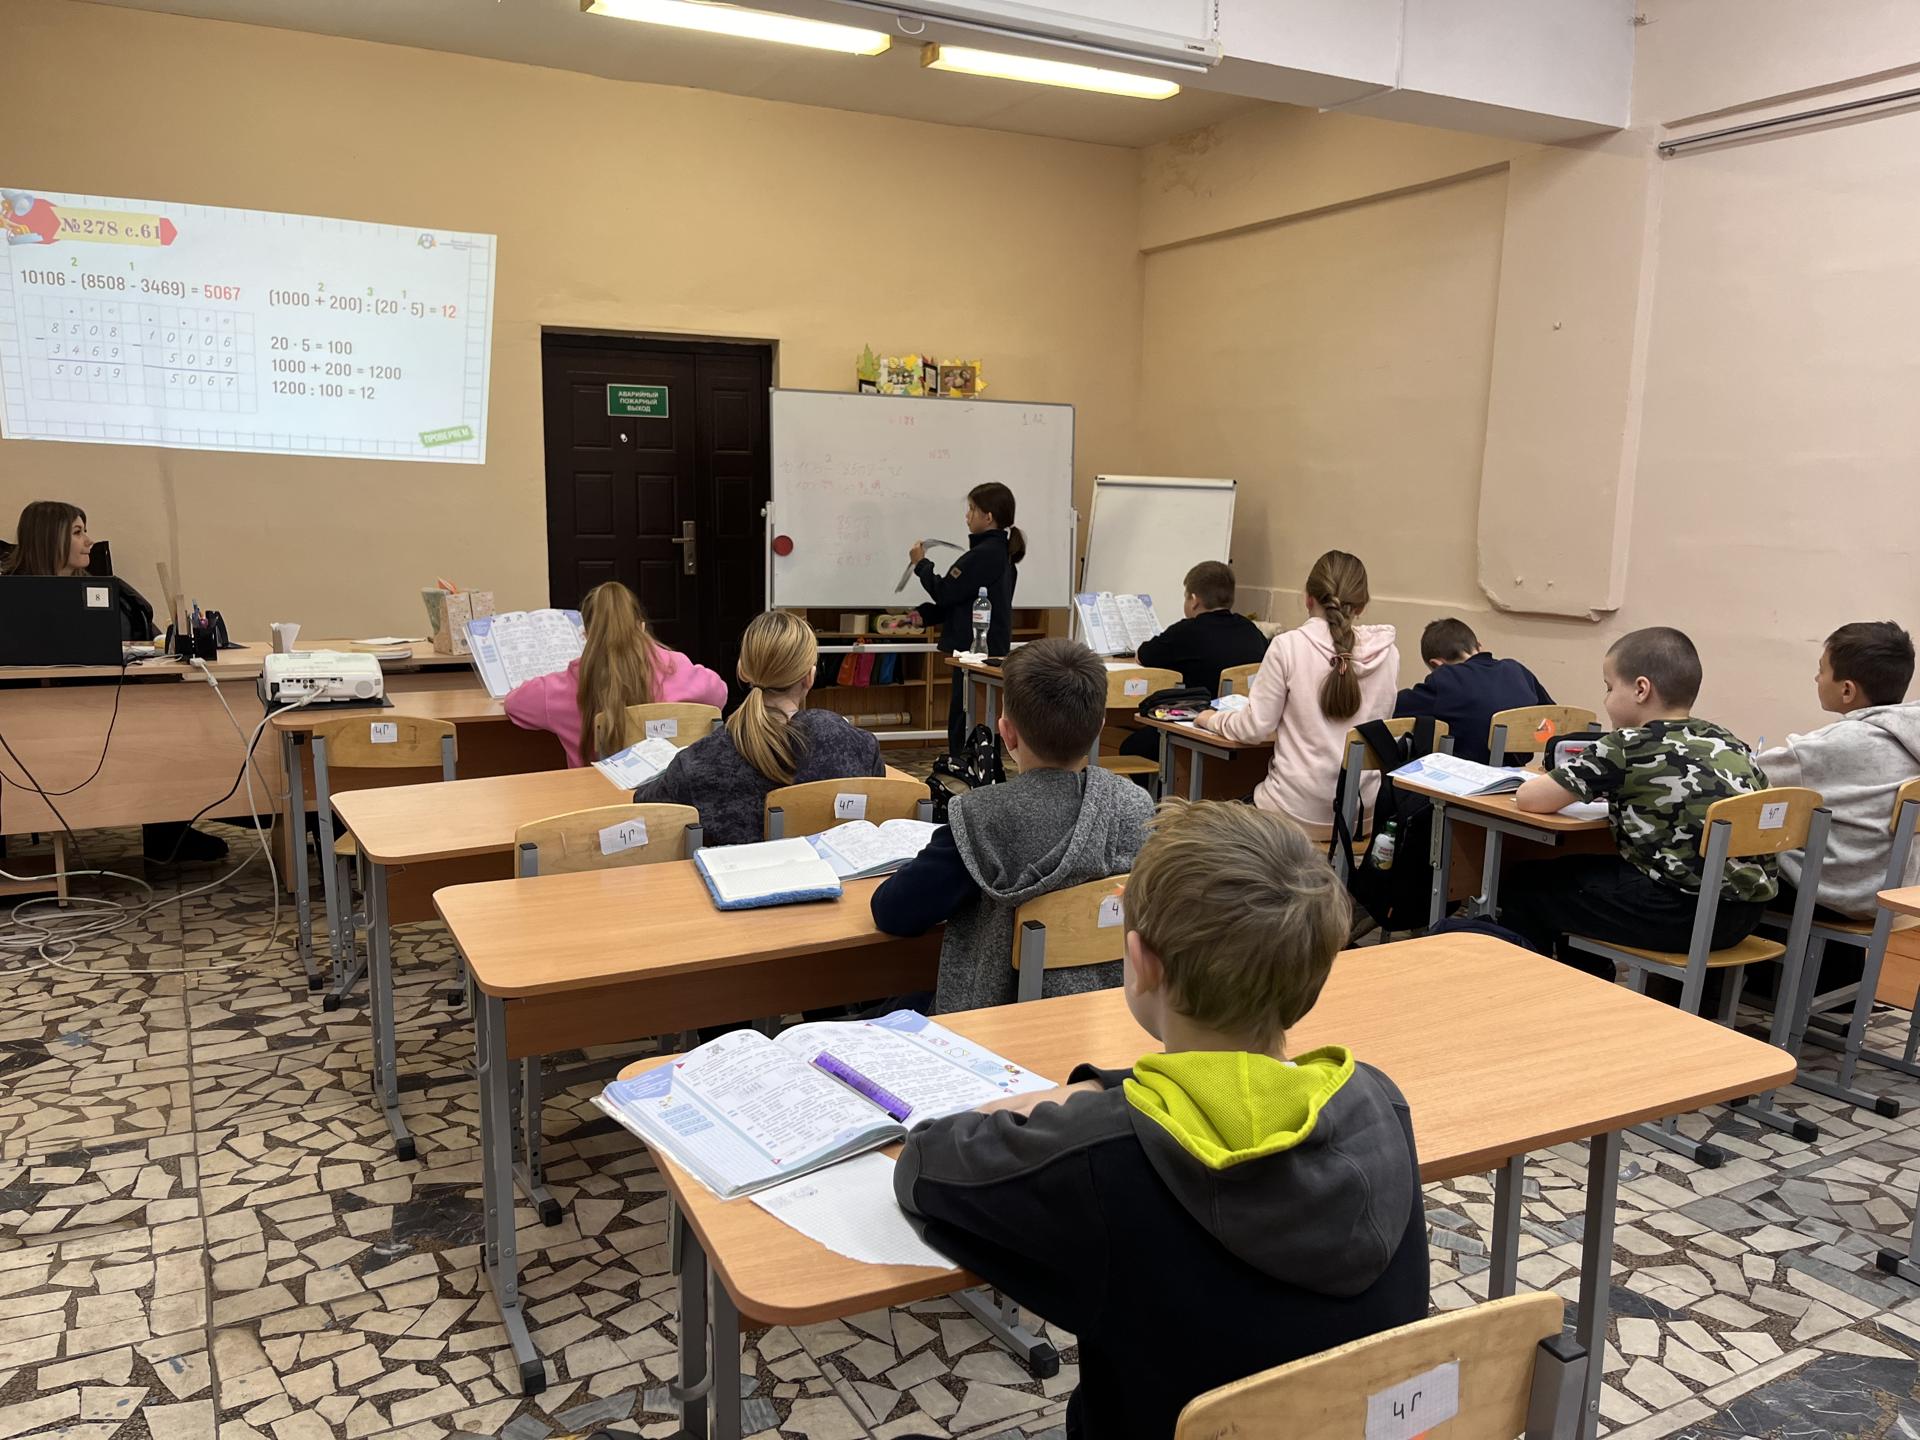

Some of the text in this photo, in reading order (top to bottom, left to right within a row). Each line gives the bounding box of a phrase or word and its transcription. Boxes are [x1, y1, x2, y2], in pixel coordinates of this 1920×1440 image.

[61, 217, 118, 234] №278
[71, 257, 78, 267] 2
[129, 262, 134, 271] 1
[20, 269, 66, 286] 10106
[81, 272, 126, 292] (8508
[140, 278, 186, 298] 3469)
[203, 284, 241, 300] 5067
[318, 282, 325, 292] 2
[367, 287, 374, 296] 3
[402, 290, 407, 298] 1
[269, 290, 310, 307] (1000
[315, 296, 325, 306] +
[330, 296, 362, 314] 200)
[375, 299, 398, 316] (20
[411, 302, 424, 318] 5)
[441, 304, 456, 319] 12
[271, 336, 288, 350] 20
[302, 338, 310, 352] 5
[328, 341, 352, 354] 100
[272, 359, 306, 374] 1000
[311, 363, 320, 373] +
[325, 362, 352, 376] 200
[369, 366, 402, 380] 1200
[272, 381, 306, 396] 1200
[319, 384, 343, 398] 100
[360, 386, 375, 400] 12
[840, 800, 854, 810] 4Г
[620, 828, 636, 844] 4Г
[1393, 1391, 1422, 1420] 4Г
